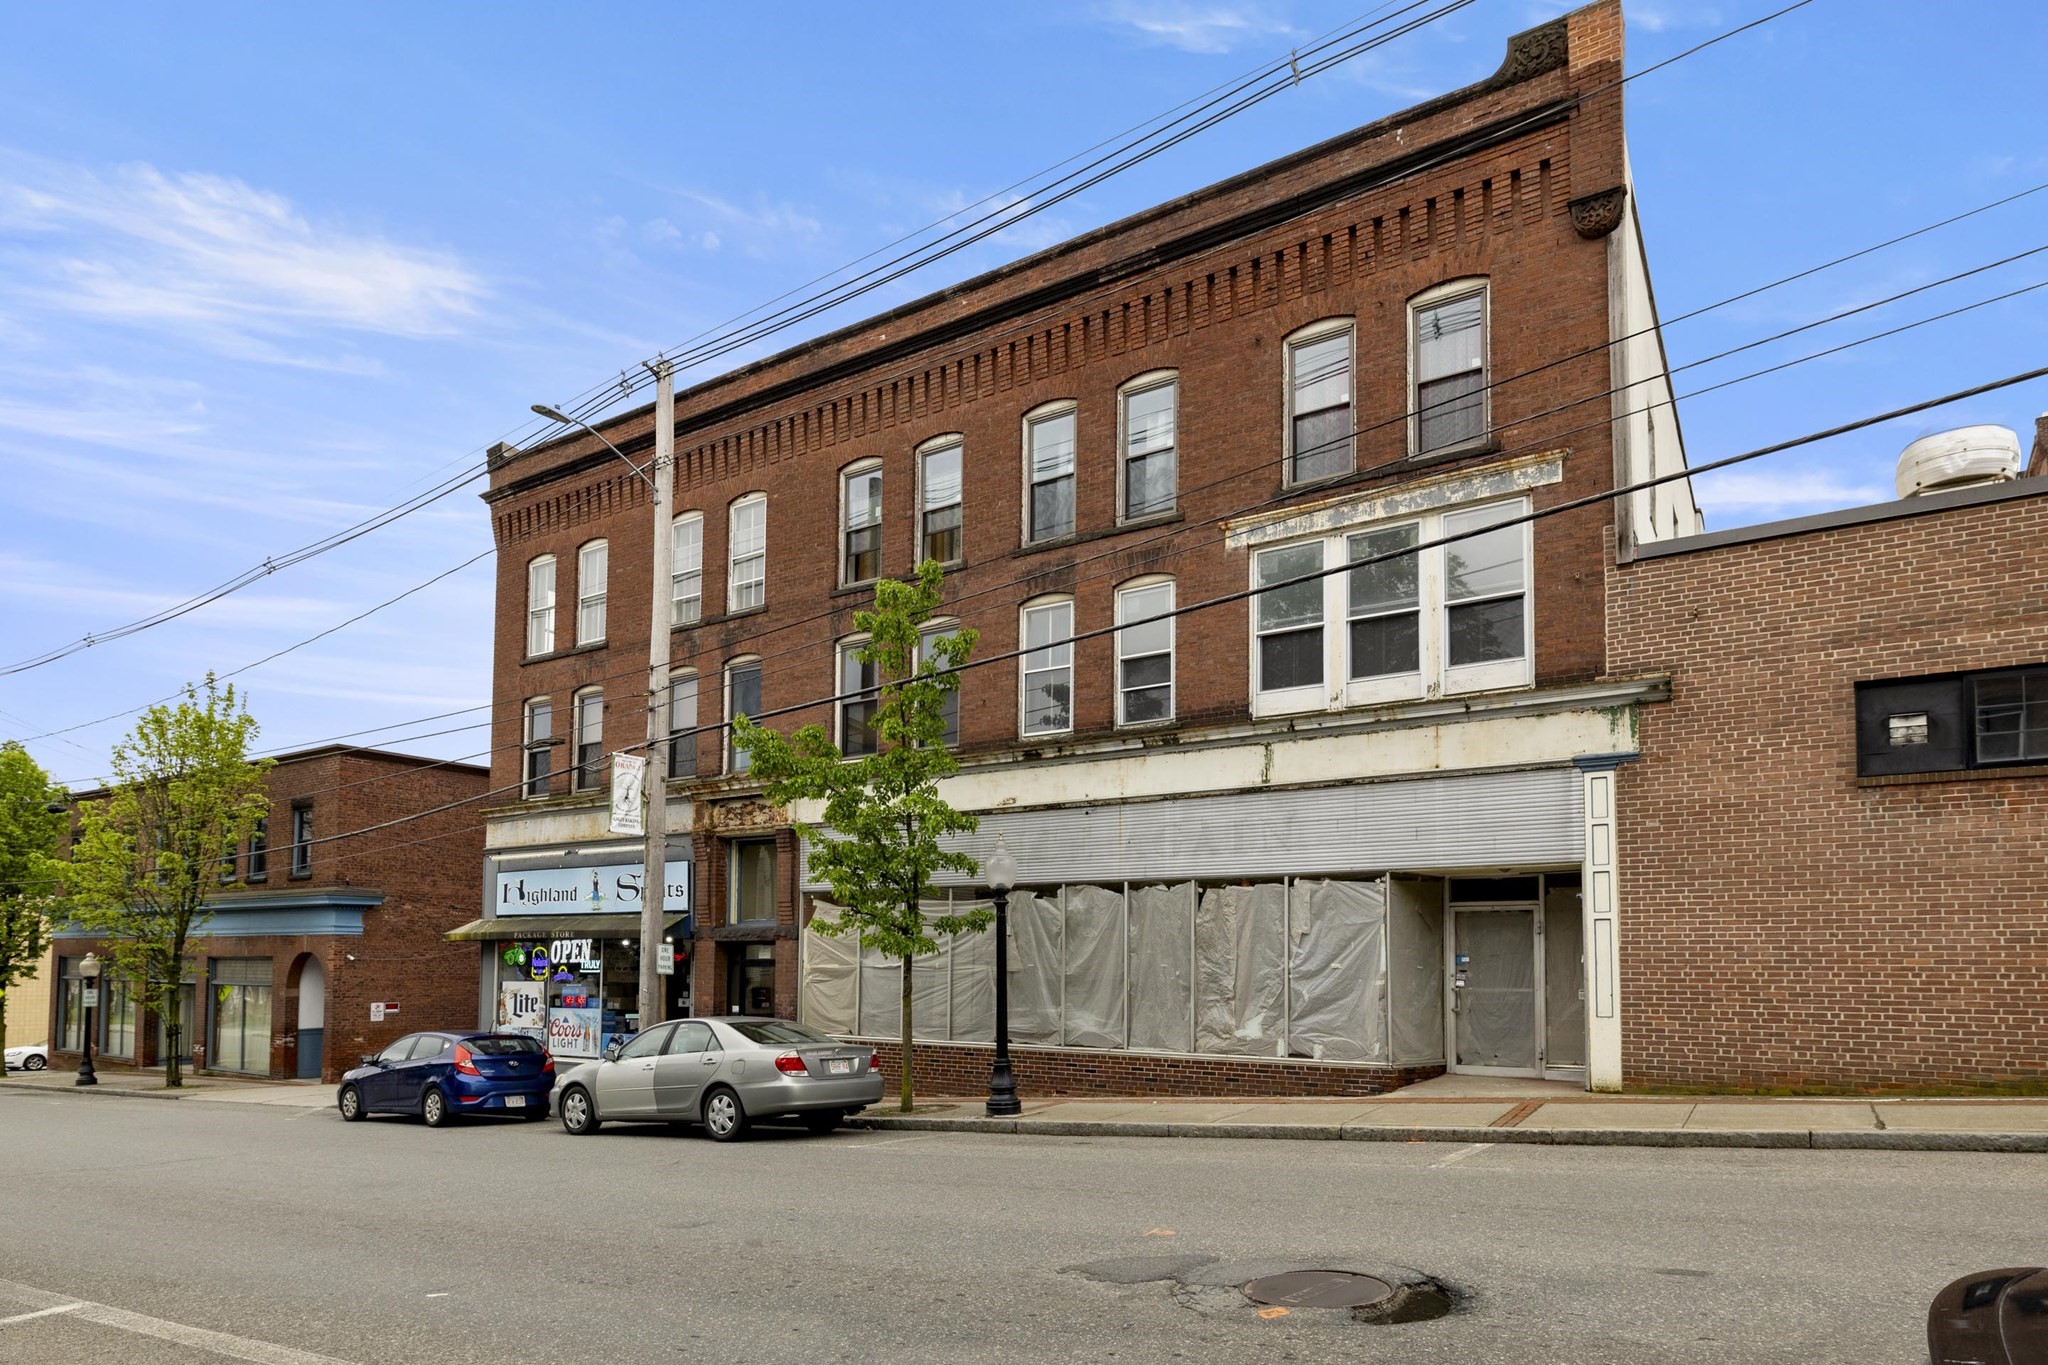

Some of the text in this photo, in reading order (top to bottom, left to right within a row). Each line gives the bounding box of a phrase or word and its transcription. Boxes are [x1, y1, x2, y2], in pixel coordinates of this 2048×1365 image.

[502, 878, 578, 906] Highland
[513, 930, 575, 939] PACKAGE STORE
[550, 938, 593, 964] OPEN
[580, 959, 601, 969] TRULY
[512, 993, 538, 1018] Lite
[549, 1018, 582, 1038] Coors
[552, 1038, 579, 1048] LIGHT
